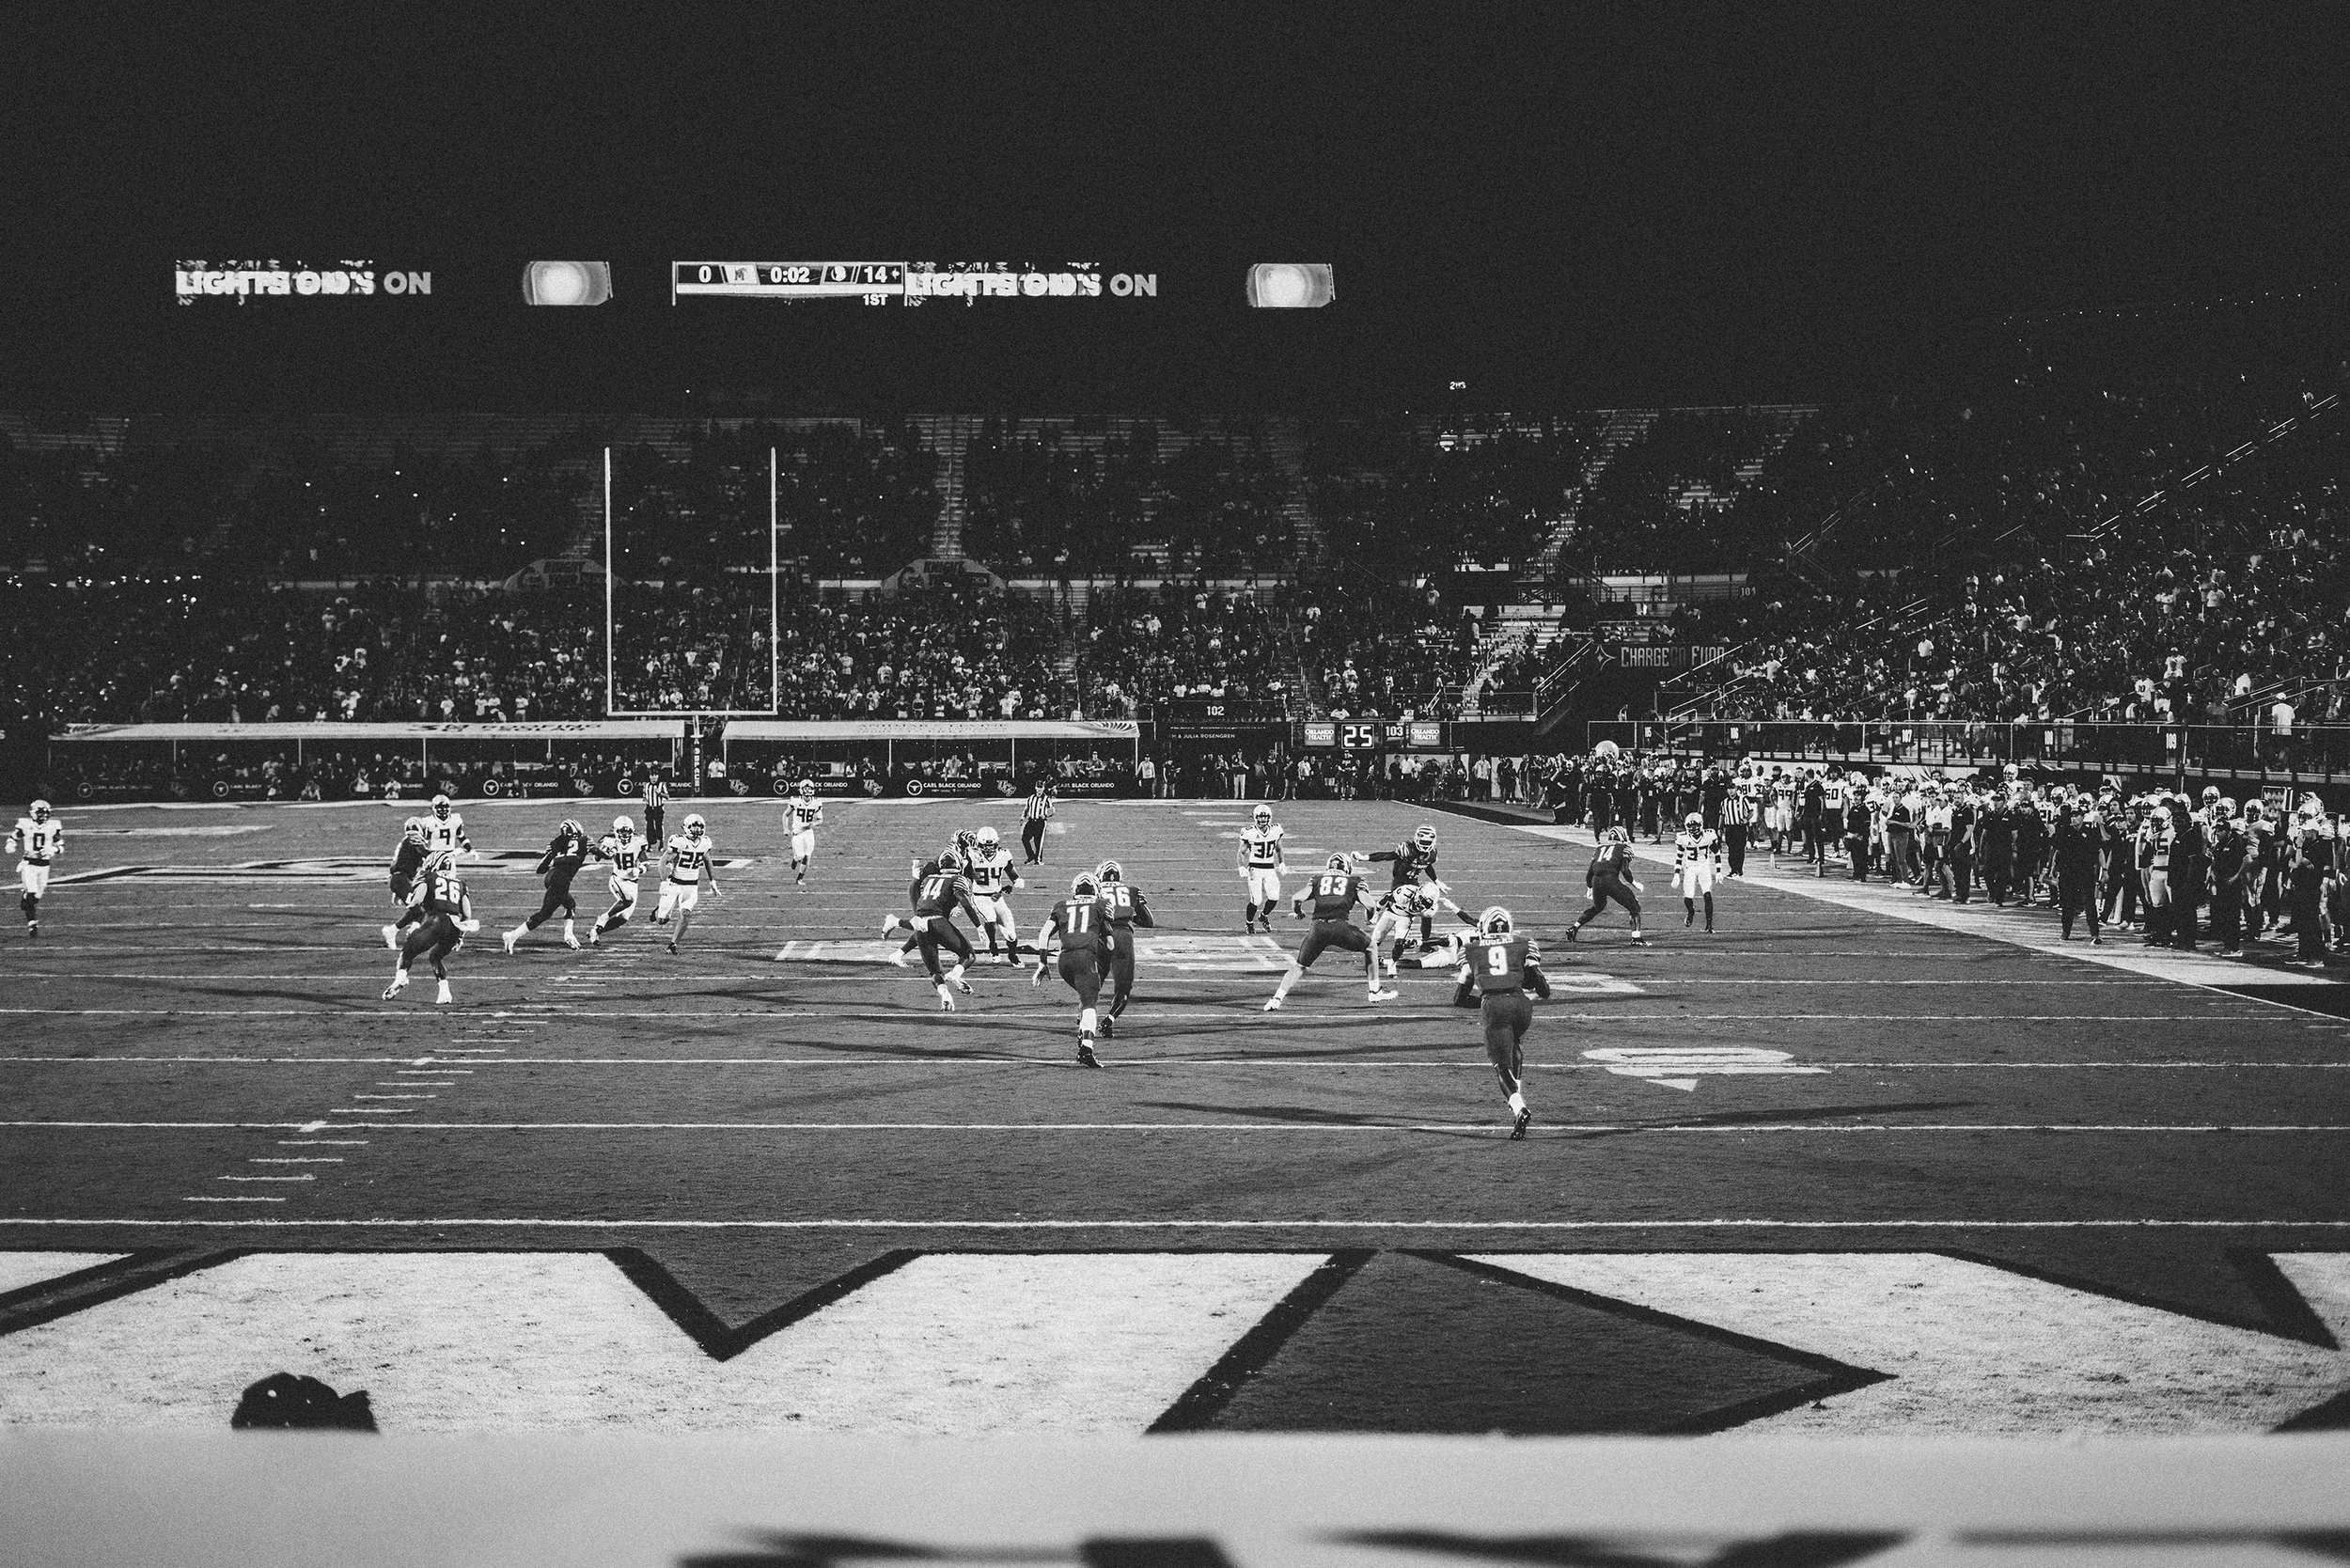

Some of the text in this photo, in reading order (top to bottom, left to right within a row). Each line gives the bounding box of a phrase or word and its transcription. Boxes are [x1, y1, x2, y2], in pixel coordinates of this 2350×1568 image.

[698, 265, 712, 283] 0
[770, 266, 810, 283] 0:02
[864, 265, 887, 283] 14
[863, 293, 888, 306] 1ST
[1206, 705, 1225, 716] 102
[1343, 726, 1372, 747] 25
[1386, 726, 1403, 736] 103
[33, 833, 46, 851] 0
[439, 828, 450, 845] 9
[1253, 839, 1277, 859] 30
[1597, 845, 1615, 862] 14
[615, 853, 635, 870] 18
[434, 876, 461, 904] 26
[1319, 876, 1349, 896] 83
[1100, 886, 1131, 907] 56
[1066, 904, 1090, 933] 11
[1487, 945, 1509, 976] 9
